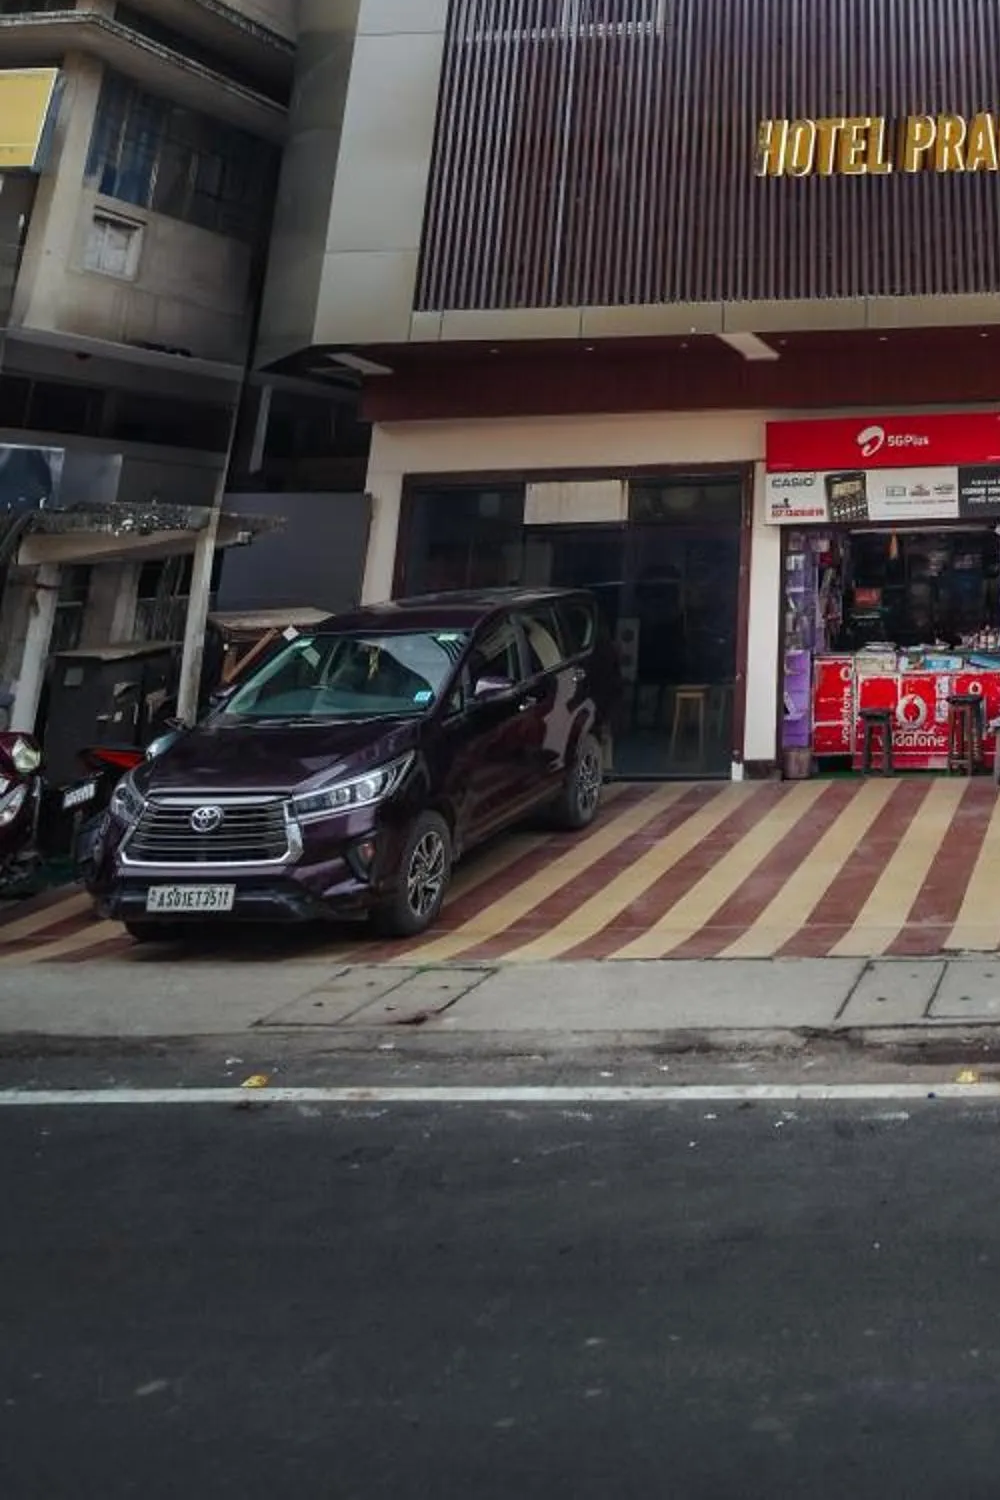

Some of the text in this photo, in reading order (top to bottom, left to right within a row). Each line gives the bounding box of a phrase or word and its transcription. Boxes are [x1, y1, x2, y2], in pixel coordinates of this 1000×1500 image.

[754, 116, 893, 177] HOTEL
[771, 477, 814, 488] CASIO
[877, 729, 946, 747] vdafone
